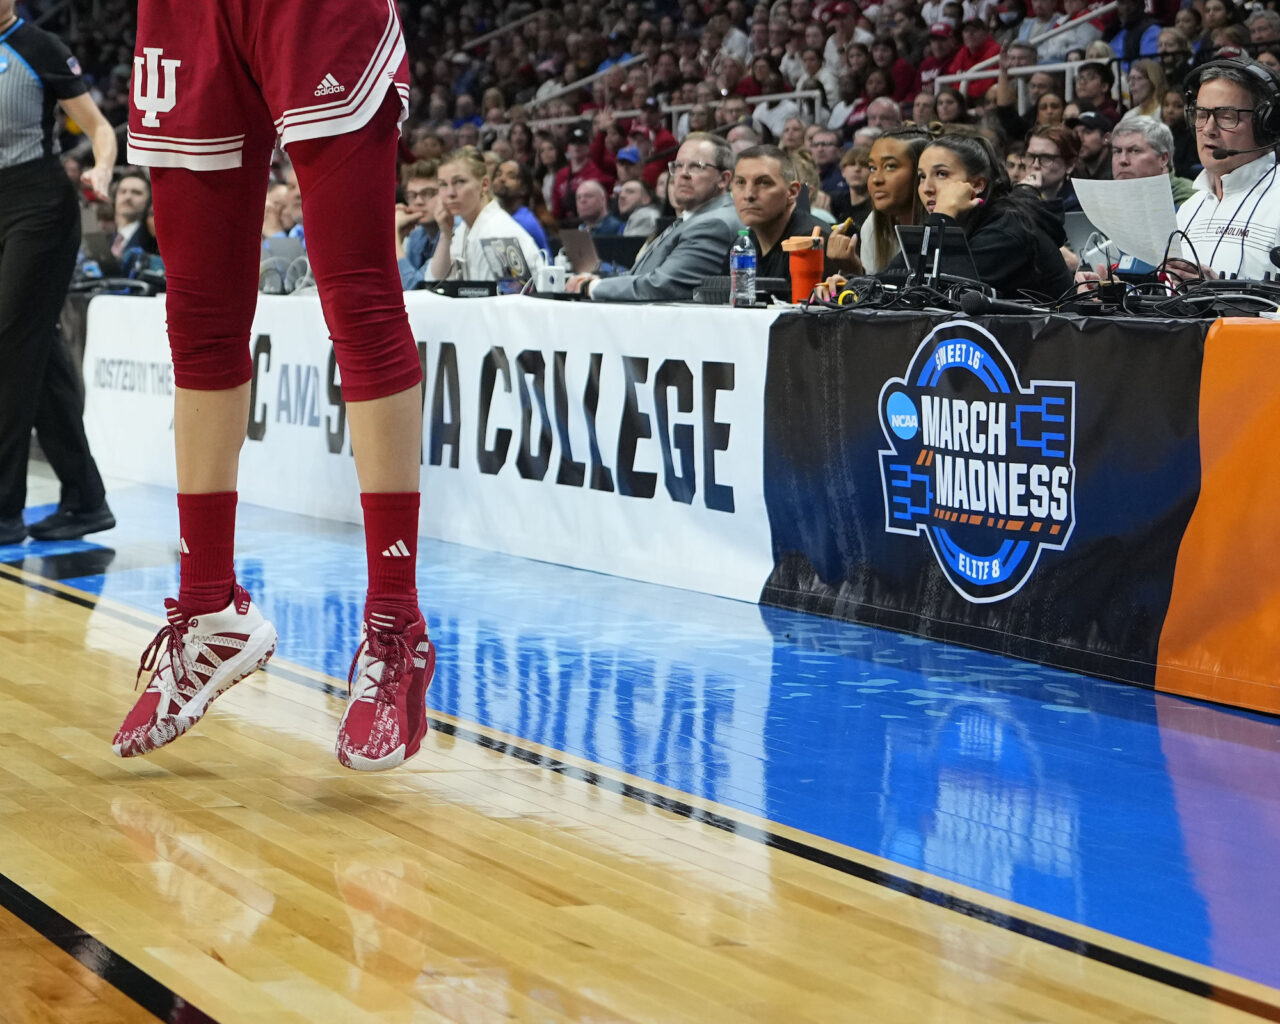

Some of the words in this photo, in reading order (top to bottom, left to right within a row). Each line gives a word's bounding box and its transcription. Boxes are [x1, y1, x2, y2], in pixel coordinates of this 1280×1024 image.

[314, 84, 345, 96] adidas
[934, 343, 966, 371] SWEET
[967, 345, 981, 370] 16
[151, 362, 172, 396] THE
[477, 346, 735, 513] COLLEGE
[891, 414, 918, 427] NCAA
[921, 394, 1007, 456] MARCH
[934, 454, 1070, 521] MADNESS
[991, 559, 1001, 578] 8
